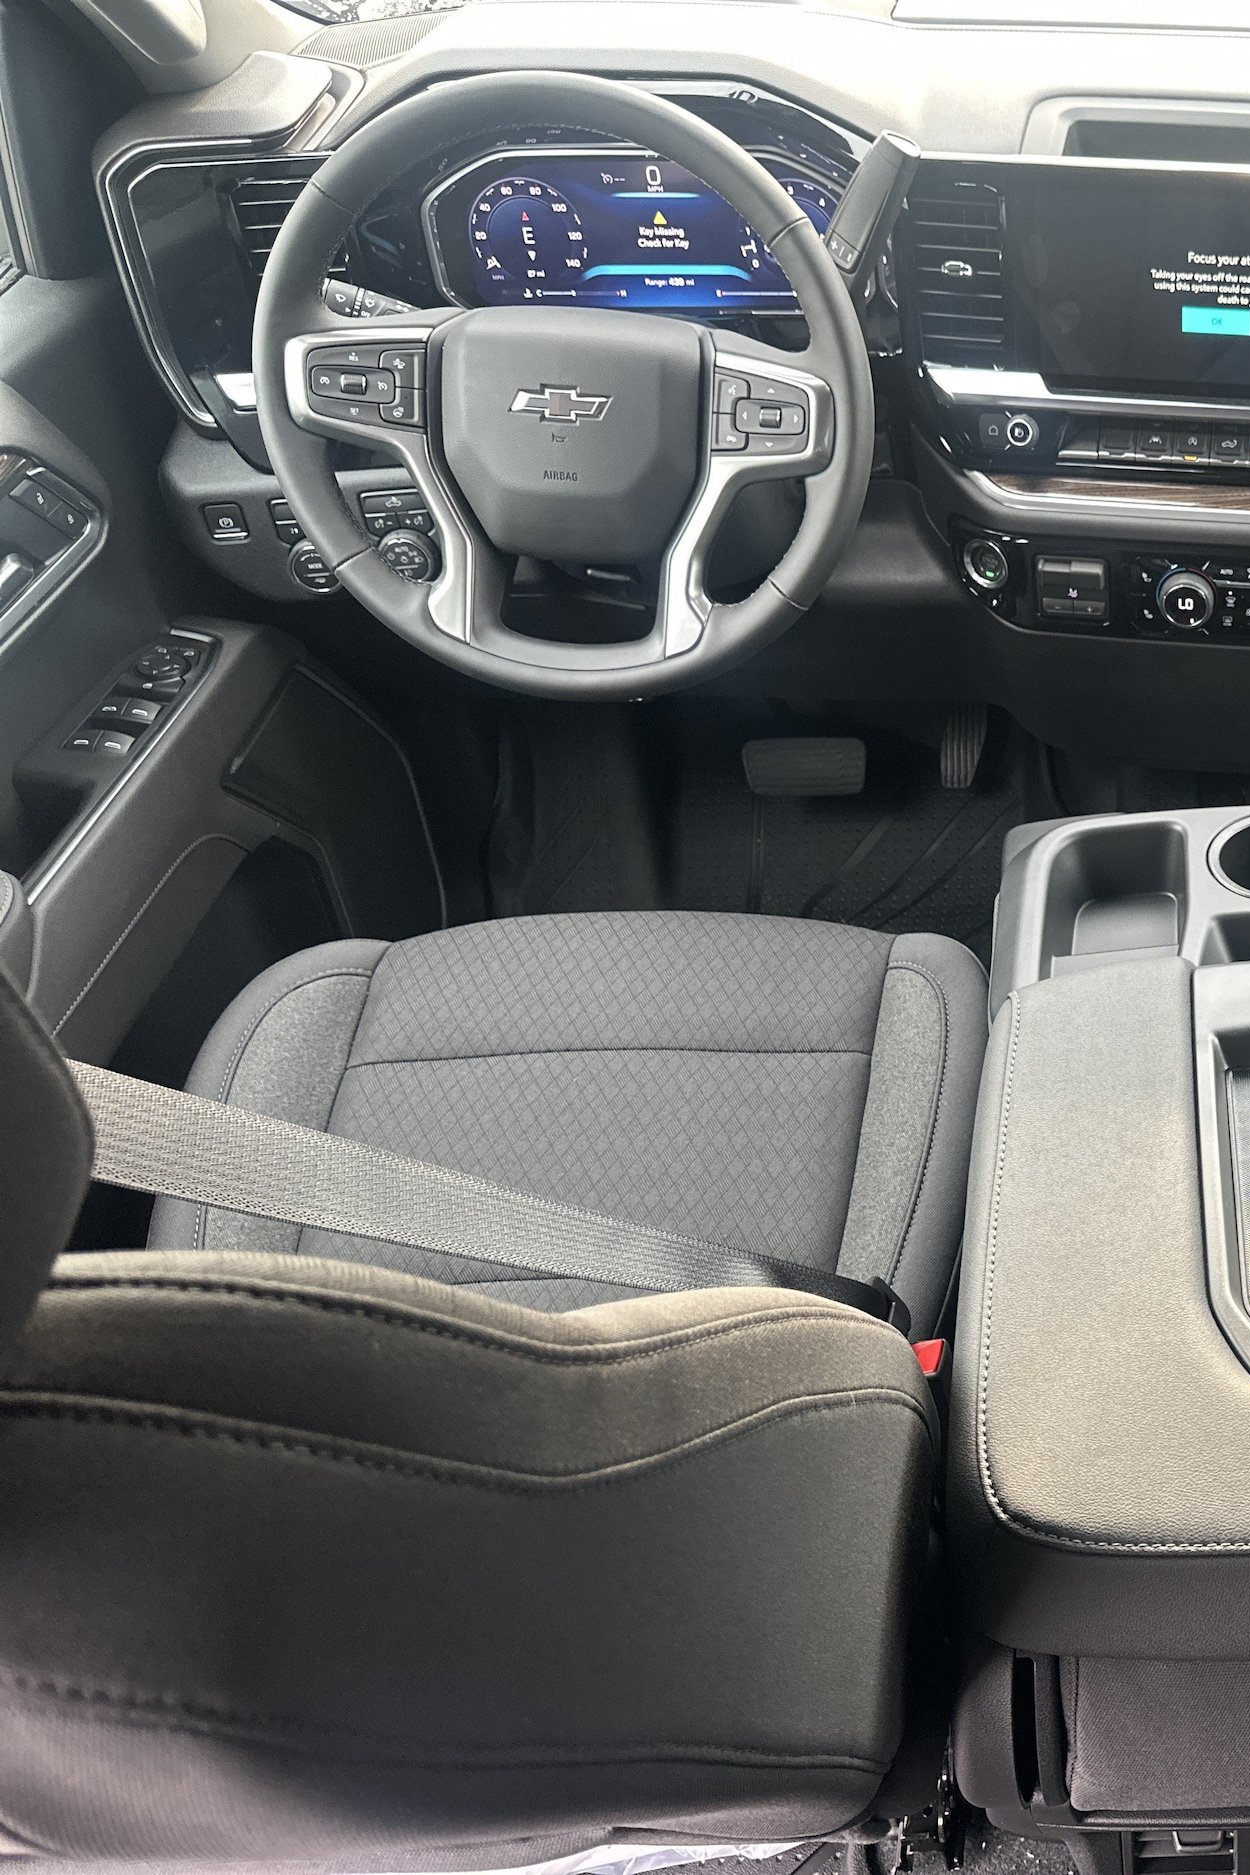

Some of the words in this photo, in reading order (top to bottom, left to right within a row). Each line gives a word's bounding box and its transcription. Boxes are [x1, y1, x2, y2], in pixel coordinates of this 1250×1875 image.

[645, 165, 661, 186] 0
[500, 186, 513, 195] 60
[529, 186, 542, 195] 80
[479, 203, 491, 212] 40
[551, 203, 567, 213] 100
[474, 231, 487, 240] 20
[522, 226, 536, 245] E
[567, 231, 582, 241] 120
[638, 226, 654, 238] Key
[654, 226, 685, 238] Missing
[637, 238, 662, 248] Check
[661, 238, 675, 248] for
[674, 239, 690, 250] Key
[565, 258, 581, 268] 140
[1187, 251, 1216, 264] Focus
[1217, 255, 1239, 267] your
[1150, 268, 1176, 281] Taking
[1176, 272, 1193, 282] your
[1194, 273, 1212, 283] eyes
[1213, 272, 1225, 282] off
[1225, 273, 1238, 282] the
[685, 278, 695, 286] mi
[1154, 282, 1176, 293] using
[1176, 282, 1191, 291] this
[1191, 283, 1218, 294] system
[1219, 284, 1240, 294] could
[1217, 294, 1239, 304] death
[1240, 296, 1249, 305] to
[1211, 318, 1223, 326] OK
[543, 470, 578, 481] AIRBAG
